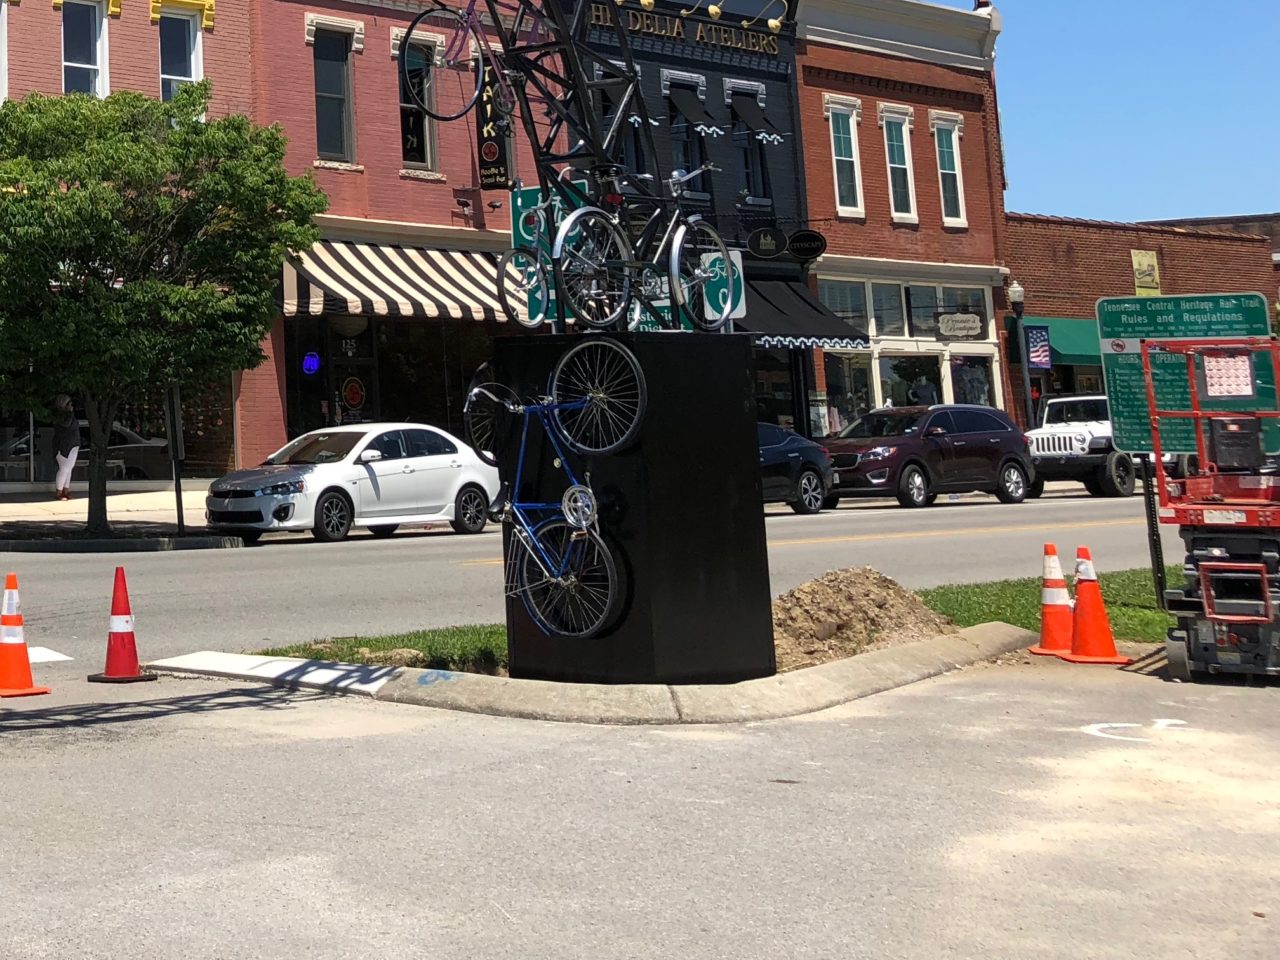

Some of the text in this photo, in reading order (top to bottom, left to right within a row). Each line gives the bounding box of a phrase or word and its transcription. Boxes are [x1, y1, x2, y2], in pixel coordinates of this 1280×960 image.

[626, 9, 685, 39] DELIA
[695, 22, 780, 55] ATELIERS
[1103, 302, 1141, 312] Tennessee
[1146, 301, 1174, 311] Central
[1180, 300, 1214, 311] Heritage
[1241, 298, 1260, 308] Trail
[1121, 312, 1243, 324] Rules and Regulations
[342, 340, 357, 348] 125
